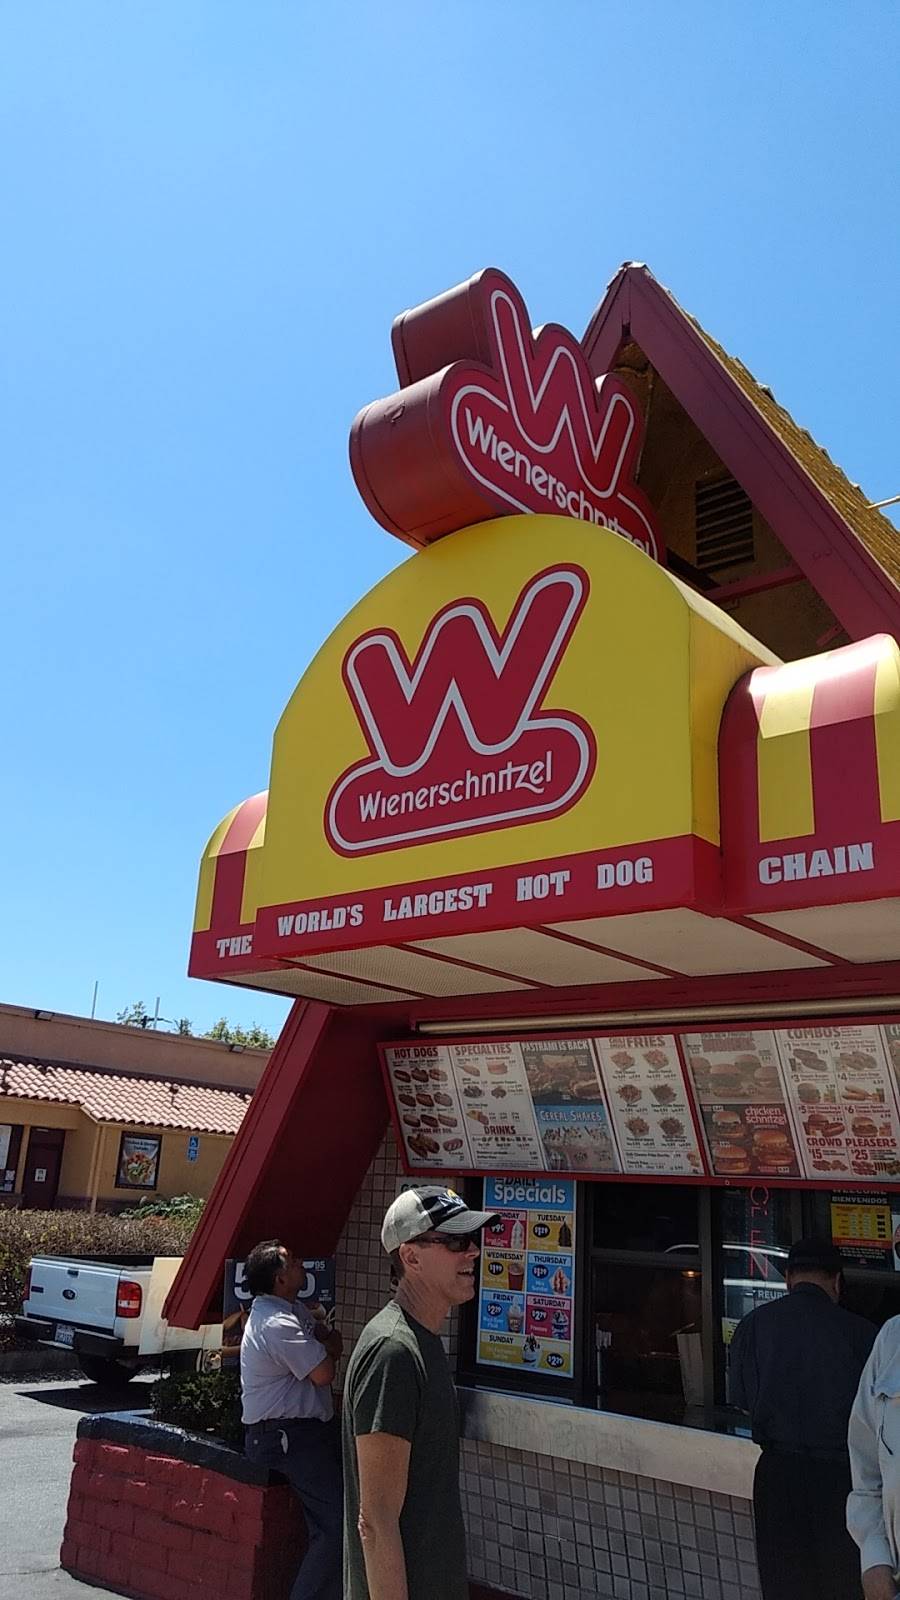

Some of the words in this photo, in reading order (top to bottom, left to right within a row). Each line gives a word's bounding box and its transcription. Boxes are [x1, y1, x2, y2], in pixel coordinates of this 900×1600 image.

[359, 750, 552, 822] Wienerschnitzel
[216, 935, 253, 958] THE
[278, 904, 364, 937] WORLD'S
[383, 883, 493, 922] LARGEST
[516, 870, 570, 902] HOT
[597, 857, 653, 889] DOG
[758, 842, 875, 885] CHAIN
[787, 1027, 840, 1039] COMBOS
[522, 1040, 558, 1051] PASTRAMI
[559, 1041, 566, 1050] IS
[567, 1039, 589, 1050] BACK
[626, 1036, 666, 1048] FRIES
[394, 1049, 412, 1058] HOT
[414, 1047, 438, 1057] DOGS
[455, 1043, 512, 1056] SPECIALTIES
[745, 1105, 782, 1115] chicken
[540, 1111, 567, 1121] CEREAL
[484, 1125, 516, 1135] DRINKS
[806, 1138, 842, 1147] CROWD
[845, 1137, 897, 1147] PLEASERS
[494, 1184, 566, 1204] Specials
[537, 1214, 566, 1222] TUESDAY
[486, 1252, 523, 1260] WEDNESDAY
[534, 1256, 567, 1264] THURSDAY
[493, 1293, 514, 1301] FRIDAY
[533, 1298, 565, 1308] SATURDAY
[489, 1335, 514, 1344] SUNDAY
